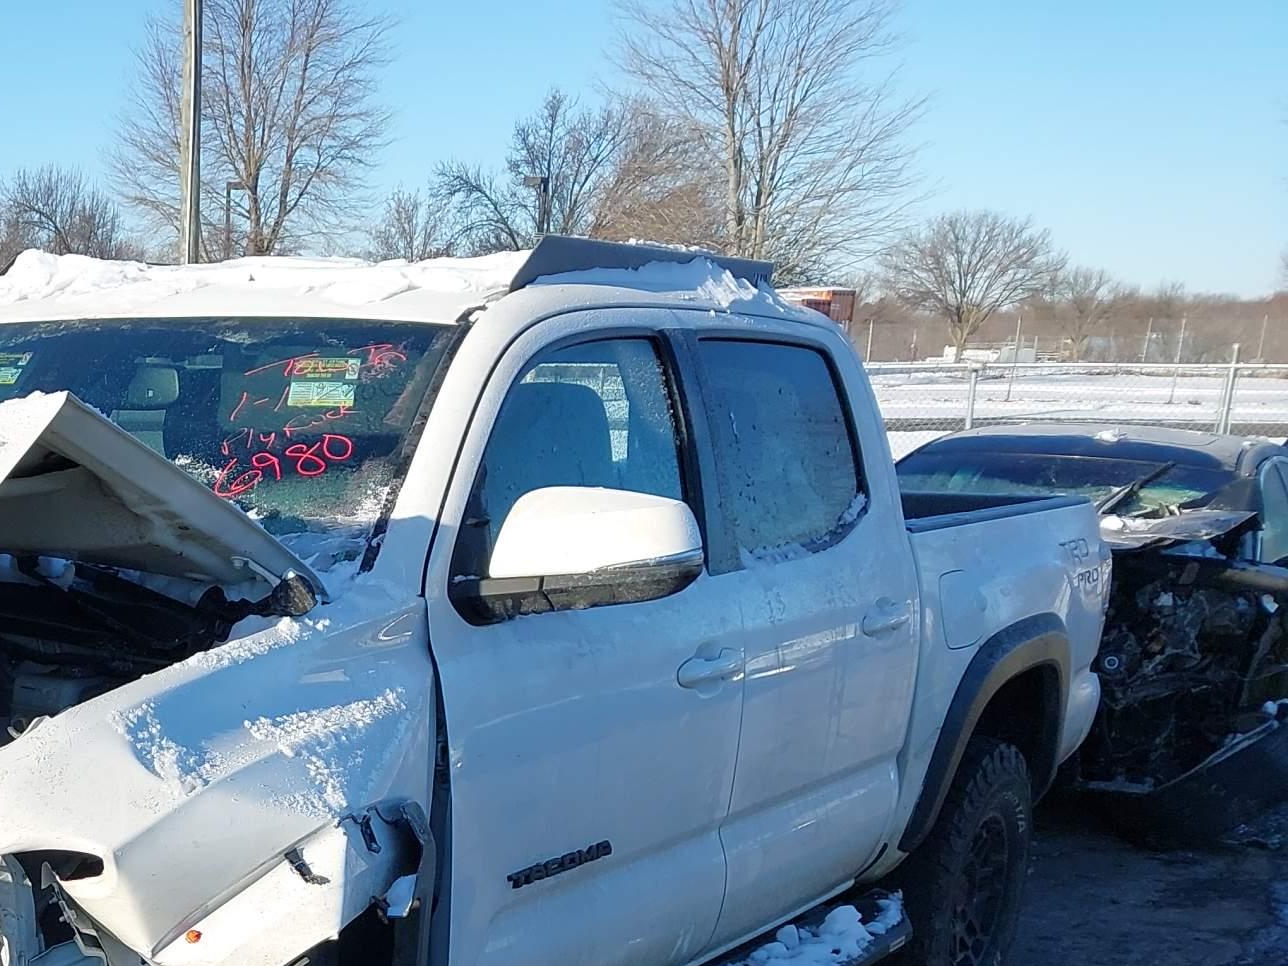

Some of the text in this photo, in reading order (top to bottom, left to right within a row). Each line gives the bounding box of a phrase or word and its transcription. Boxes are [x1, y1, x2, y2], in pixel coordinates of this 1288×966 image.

[214, 433, 353, 497] 6980
[1058, 537, 1089, 564] TRD
[506, 839, 613, 890] TACOMA
